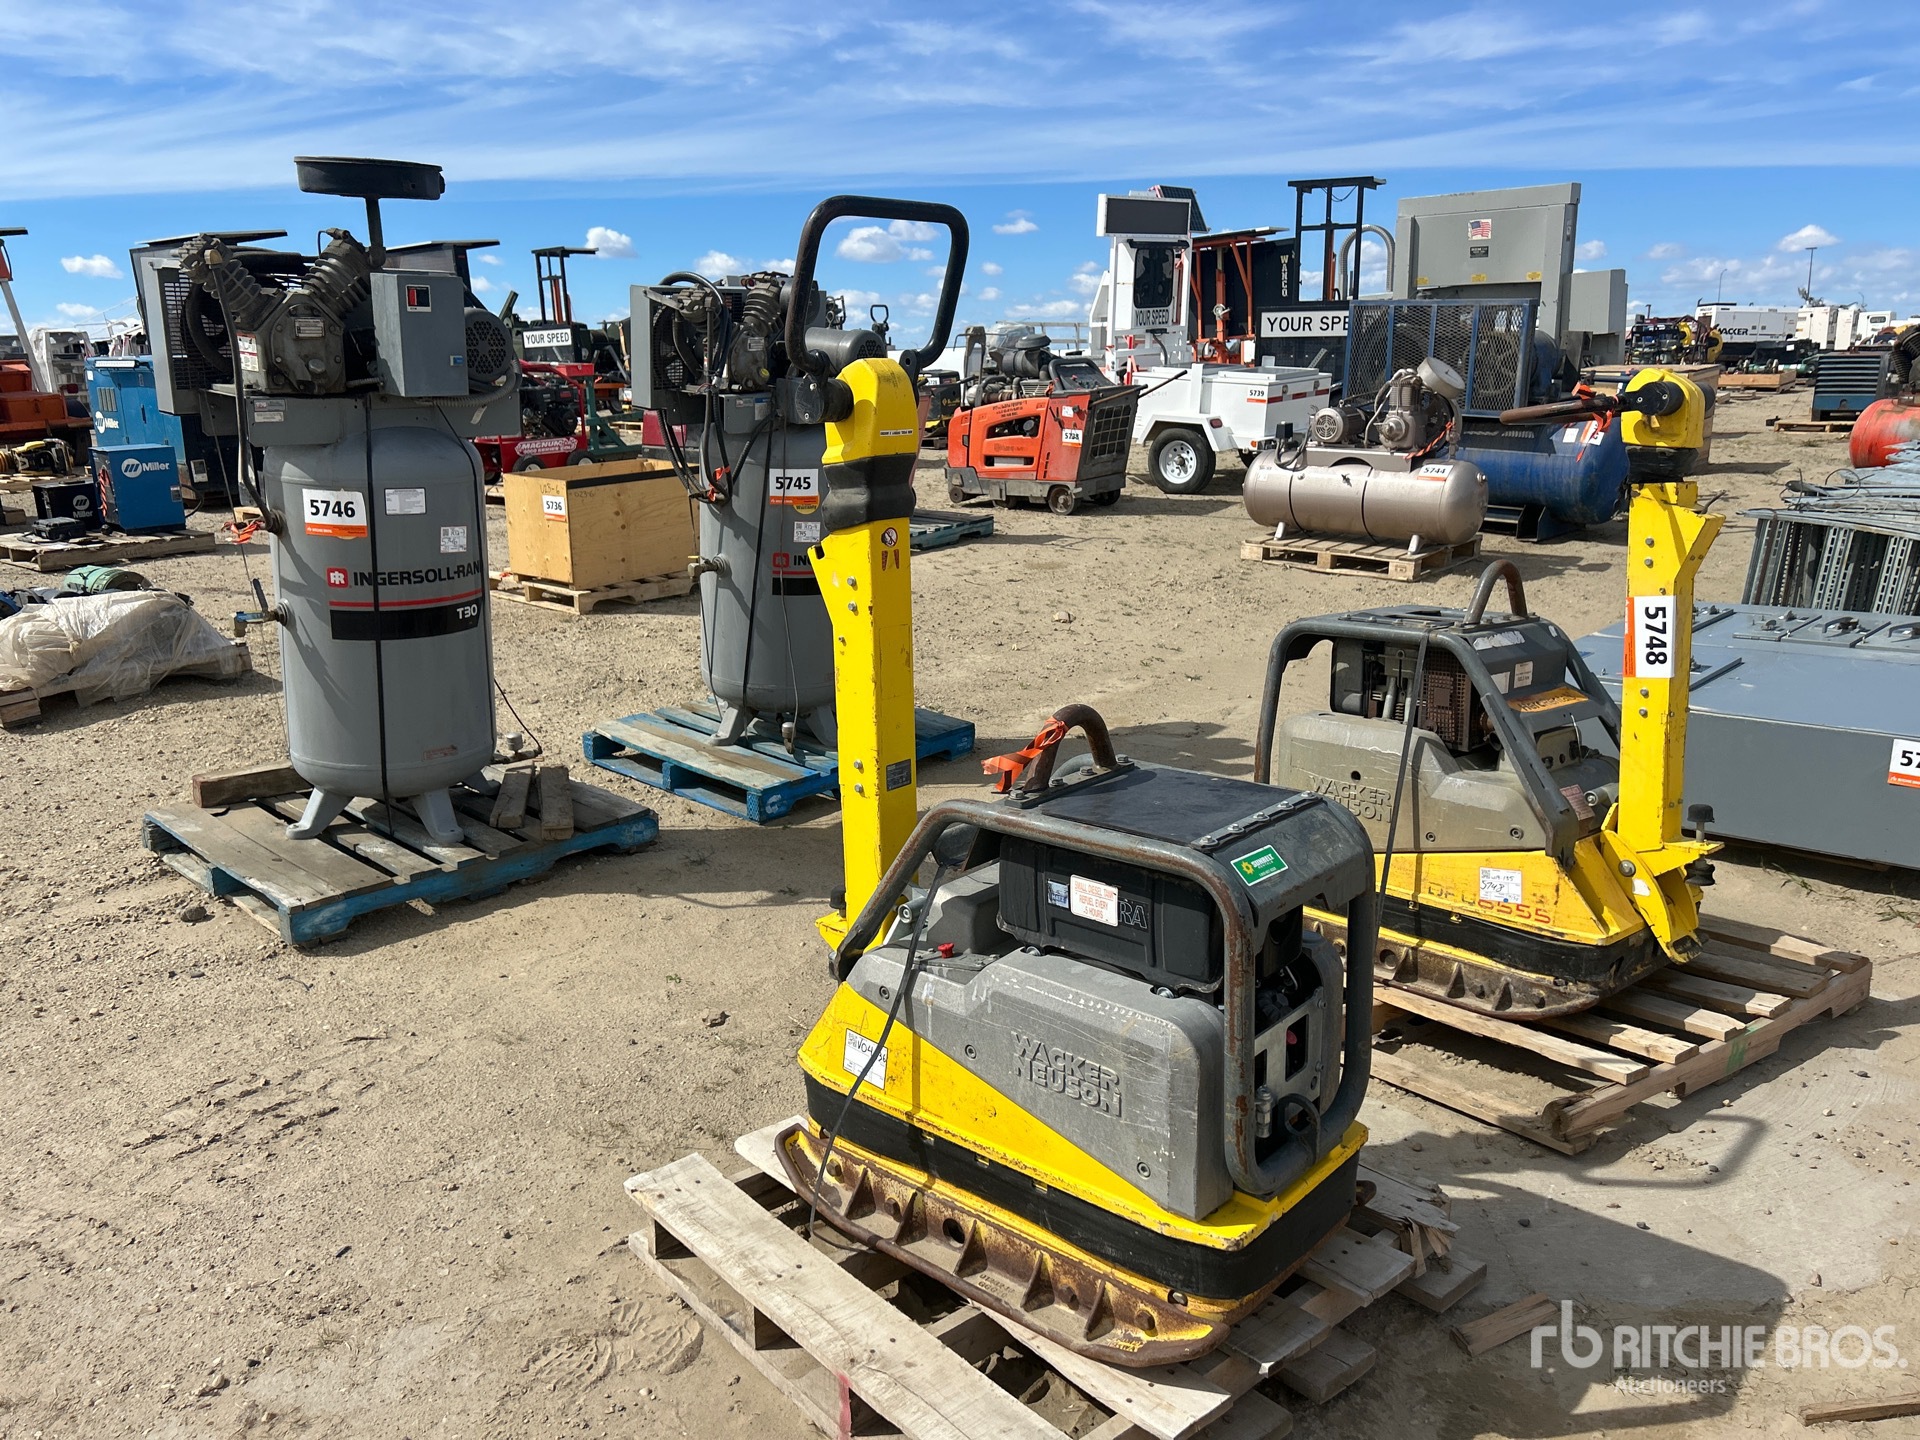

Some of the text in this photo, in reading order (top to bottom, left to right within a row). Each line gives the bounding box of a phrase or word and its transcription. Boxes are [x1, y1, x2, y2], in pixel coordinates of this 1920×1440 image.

[1280, 255, 1289, 297] WANCO
[1135, 308, 1169, 326] YOUR SPEED
[1267, 315, 1349, 332] YOUR SPE
[525, 332, 569, 345] YOUR SPEED
[1249, 389, 1265, 397] 5739
[519, 440, 563, 449] MAGNUM
[142, 461, 170, 471] Miller
[775, 476, 811, 490] 5745
[310, 499, 355, 518] 5746
[546, 500, 562, 511] 5736
[354, 560, 481, 586] INGERSOLL-RAN
[457, 604, 478, 619] T30
[1645, 606, 1668, 665] 5748
[1308, 775, 1393, 808] WACKER
[1074, 880, 1087, 893] SMALL
[1088, 884, 1103, 897] DIESEL
[1079, 895, 1109, 910] REFUEL EVERY
[1089, 908, 1104, 919] HOURS
[1119, 900, 1147, 929] RA
[1011, 1031, 1120, 1092] WACKER
[1014, 1053, 1122, 1118] NEUSON
